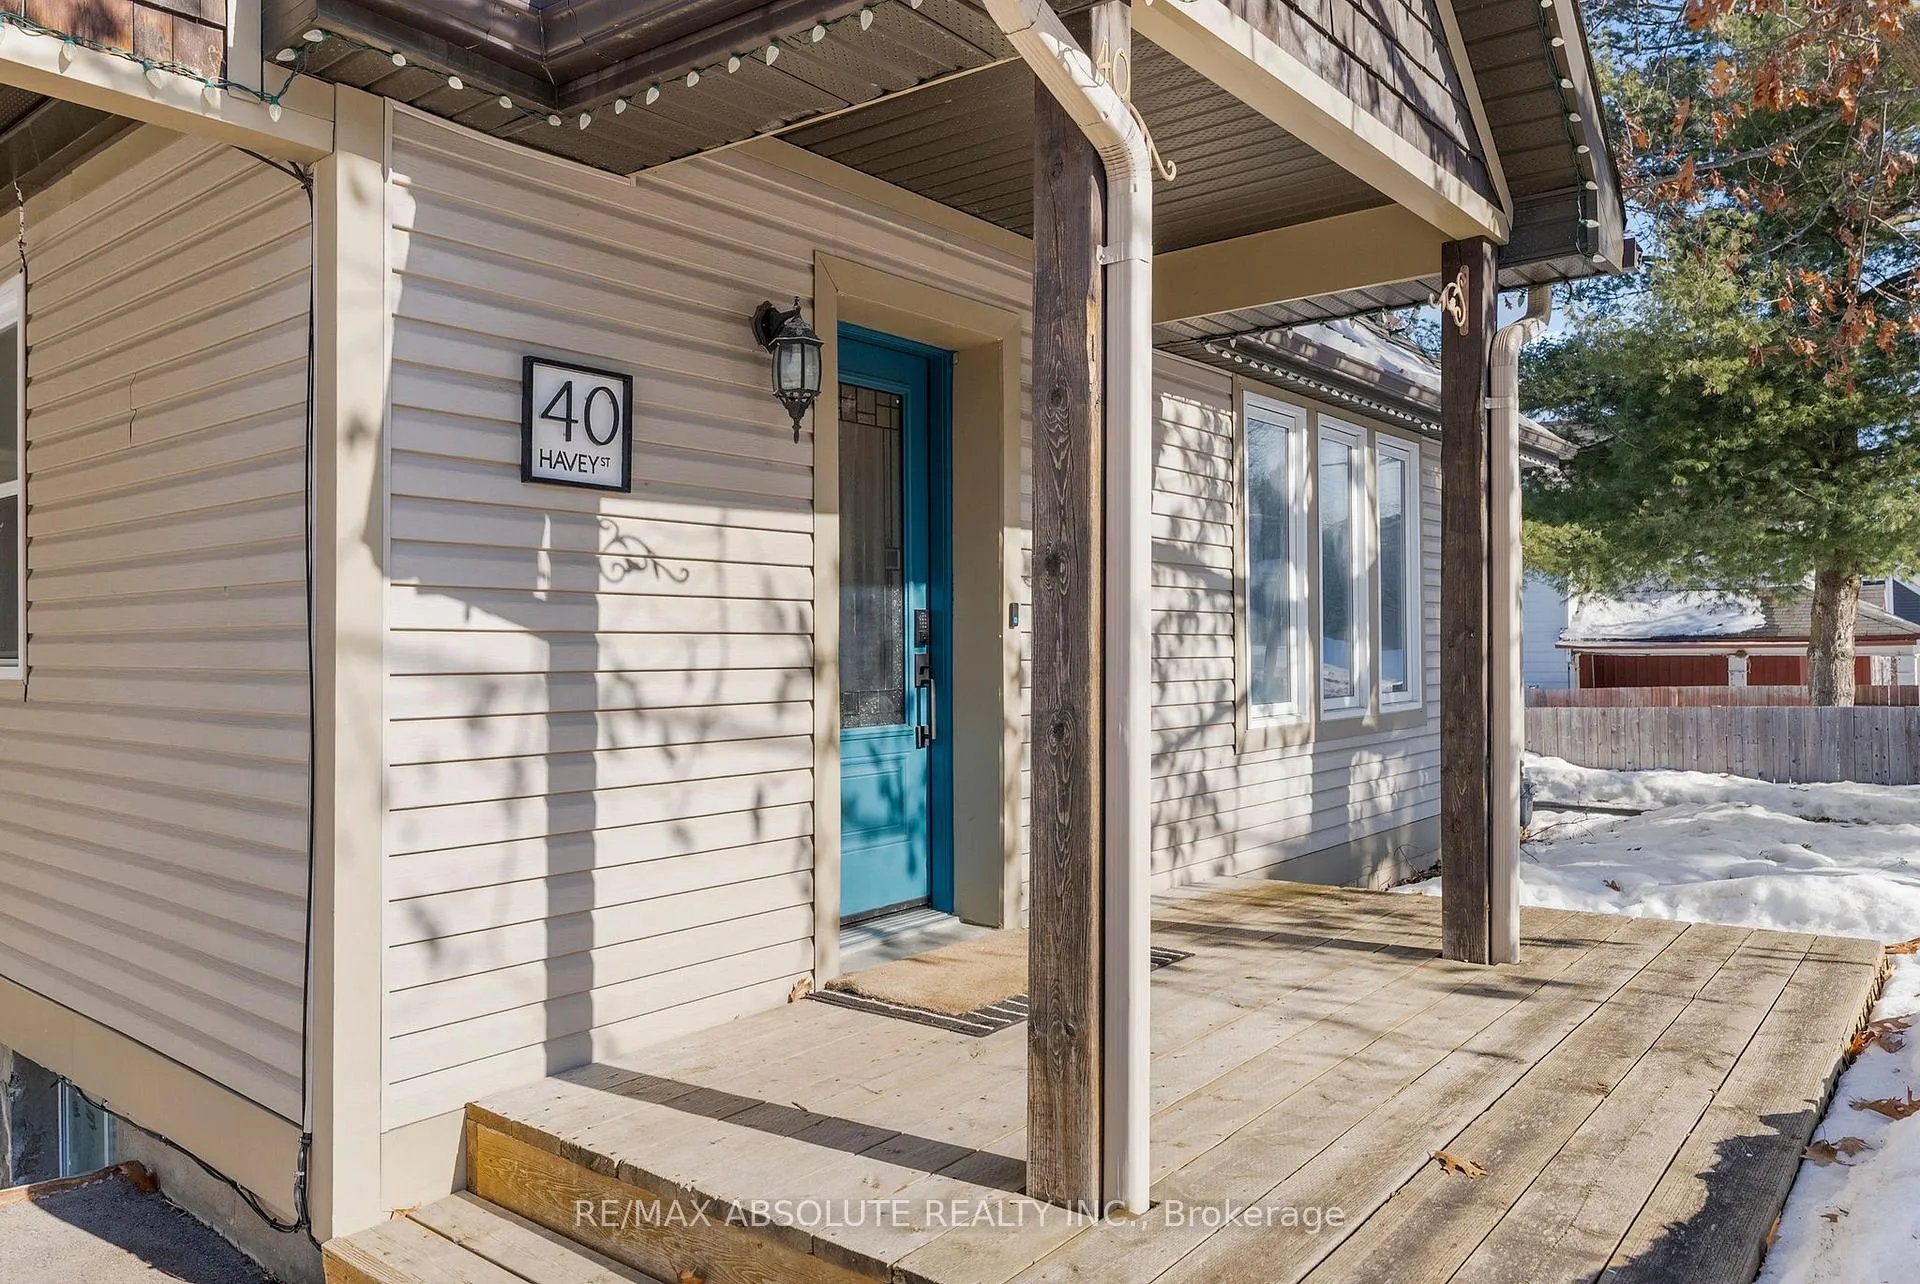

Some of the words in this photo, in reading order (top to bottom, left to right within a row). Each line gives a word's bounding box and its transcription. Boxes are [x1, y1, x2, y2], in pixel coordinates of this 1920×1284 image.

[1096, 37, 1130, 104] 40
[540, 380, 620, 446] 40
[539, 448, 599, 474] HAVEY
